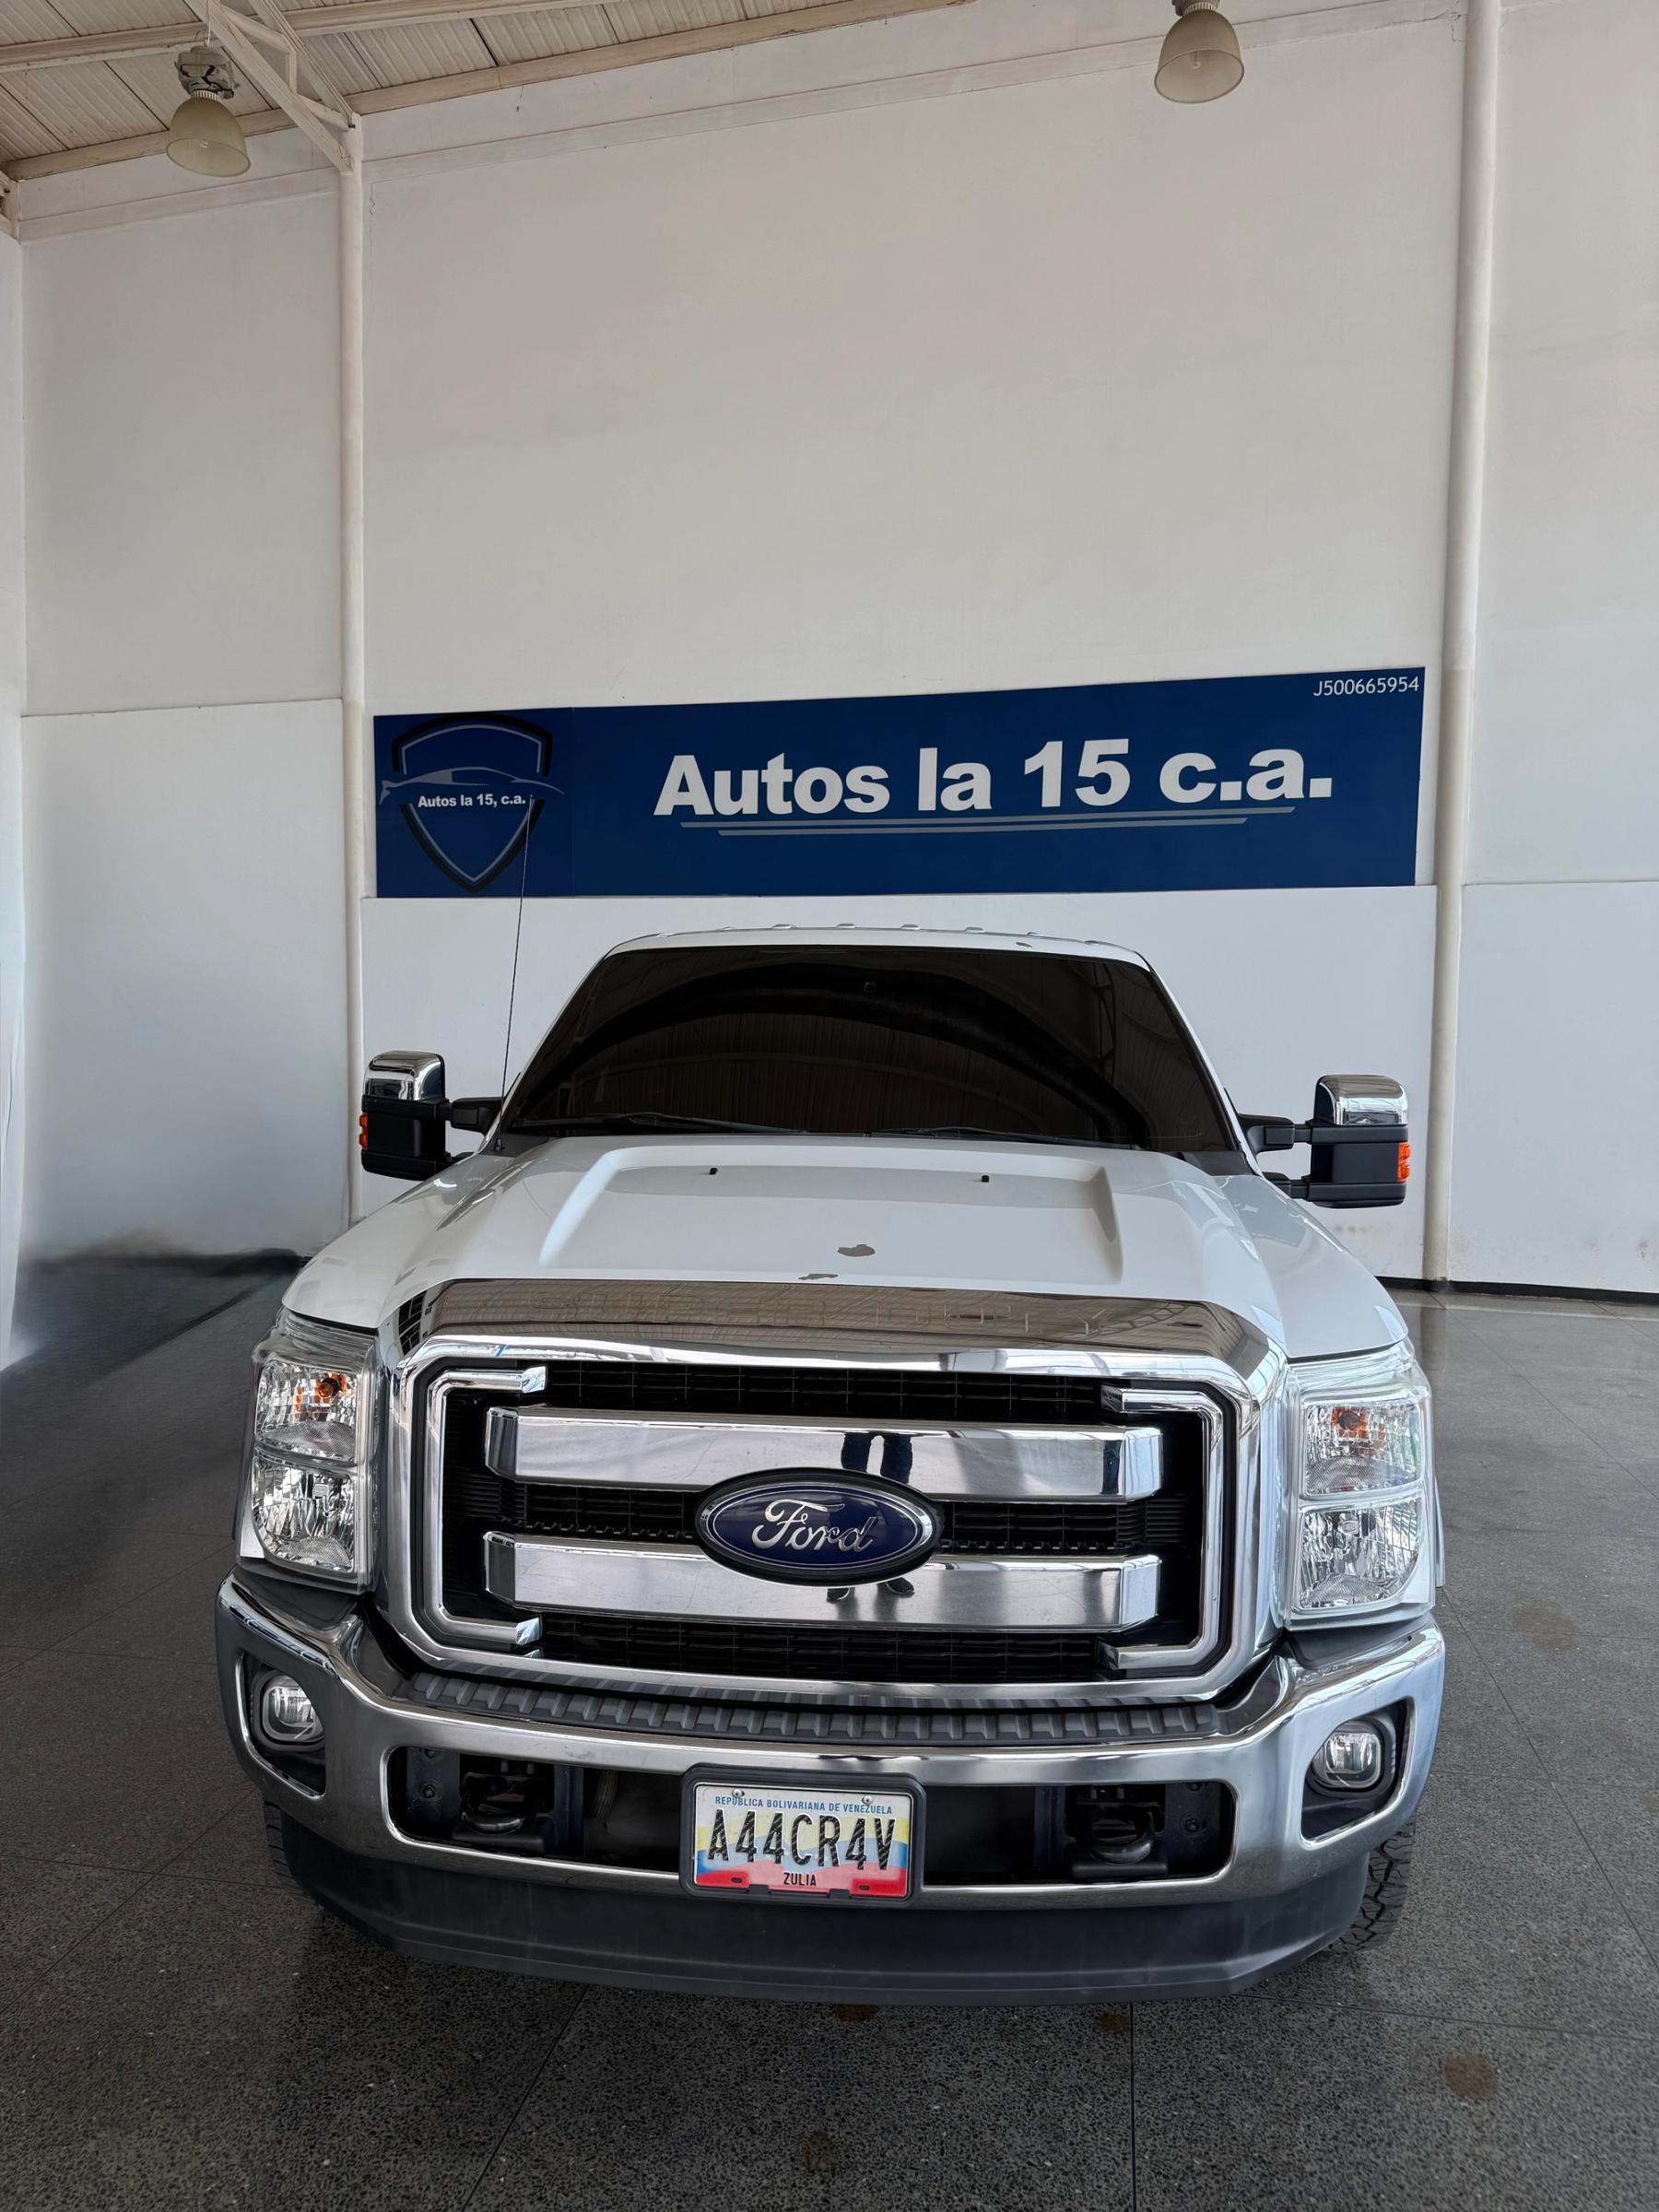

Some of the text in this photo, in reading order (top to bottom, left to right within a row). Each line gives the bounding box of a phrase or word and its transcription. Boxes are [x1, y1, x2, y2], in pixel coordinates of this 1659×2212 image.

[1312, 676, 1419, 697] J500665954
[653, 738, 1334, 816] Autos la 15 c.a.
[418, 793, 526, 808] Autos la 15, c.a.
[751, 1498, 877, 1552] Ford
[767, 1799, 826, 1812] BOLIVARIANA
[829, 1802, 841, 1812] DE
[843, 1804, 893, 1815] VENEZUELA
[707, 1807, 897, 1872] A44CR4V
[783, 1872, 817, 1887] ZULIA
